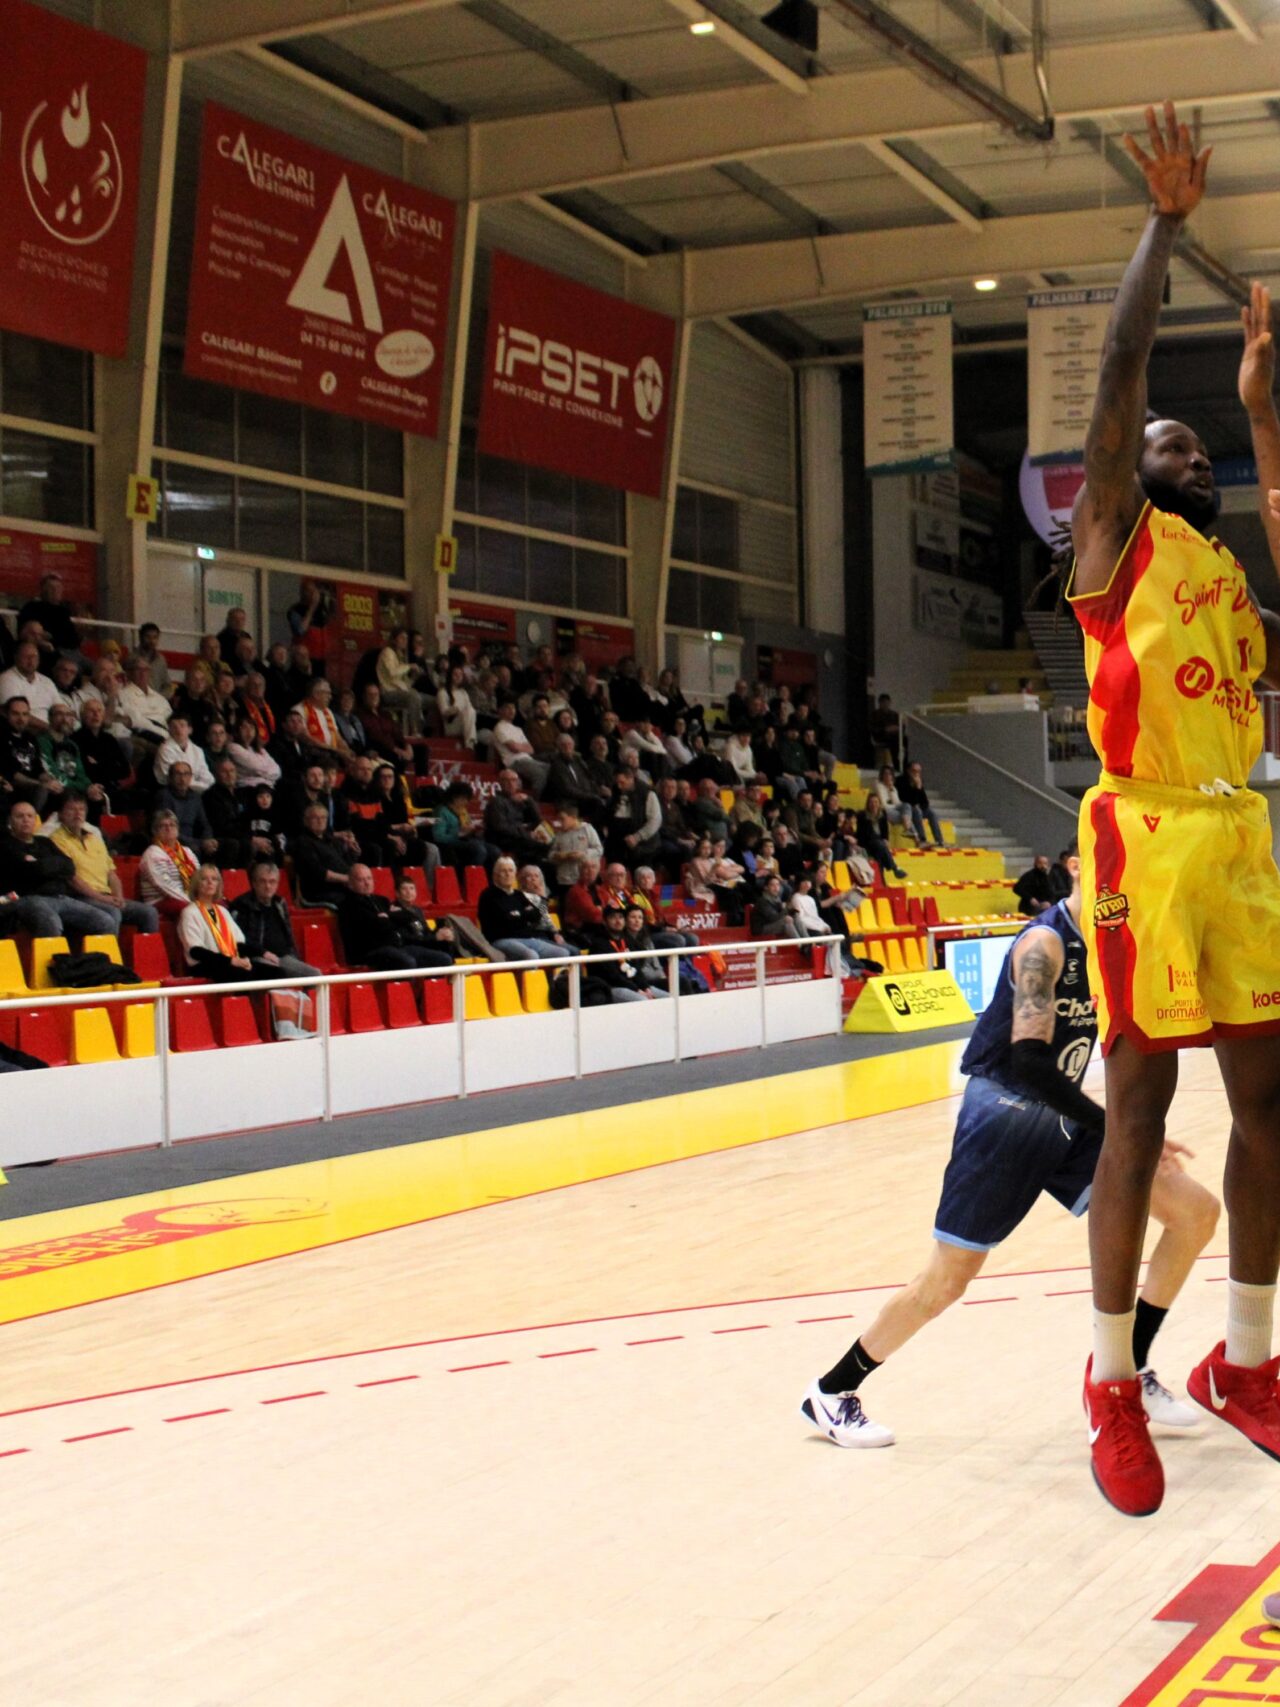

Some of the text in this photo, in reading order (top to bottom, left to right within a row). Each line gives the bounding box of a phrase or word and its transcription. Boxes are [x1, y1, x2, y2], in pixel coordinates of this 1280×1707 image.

[217, 132, 315, 192] CALEGARI
[256, 174, 316, 208] Bâtiment
[362, 190, 443, 241] CALEGARI
[200, 331, 256, 356] CALEGARI
[135, 481, 150, 516] E
[440, 541, 451, 567] D
[691, 912, 721, 929] SPORT
[905, 985, 957, 1002] DELMONICO
[911, 1001, 944, 1014] DOREL
